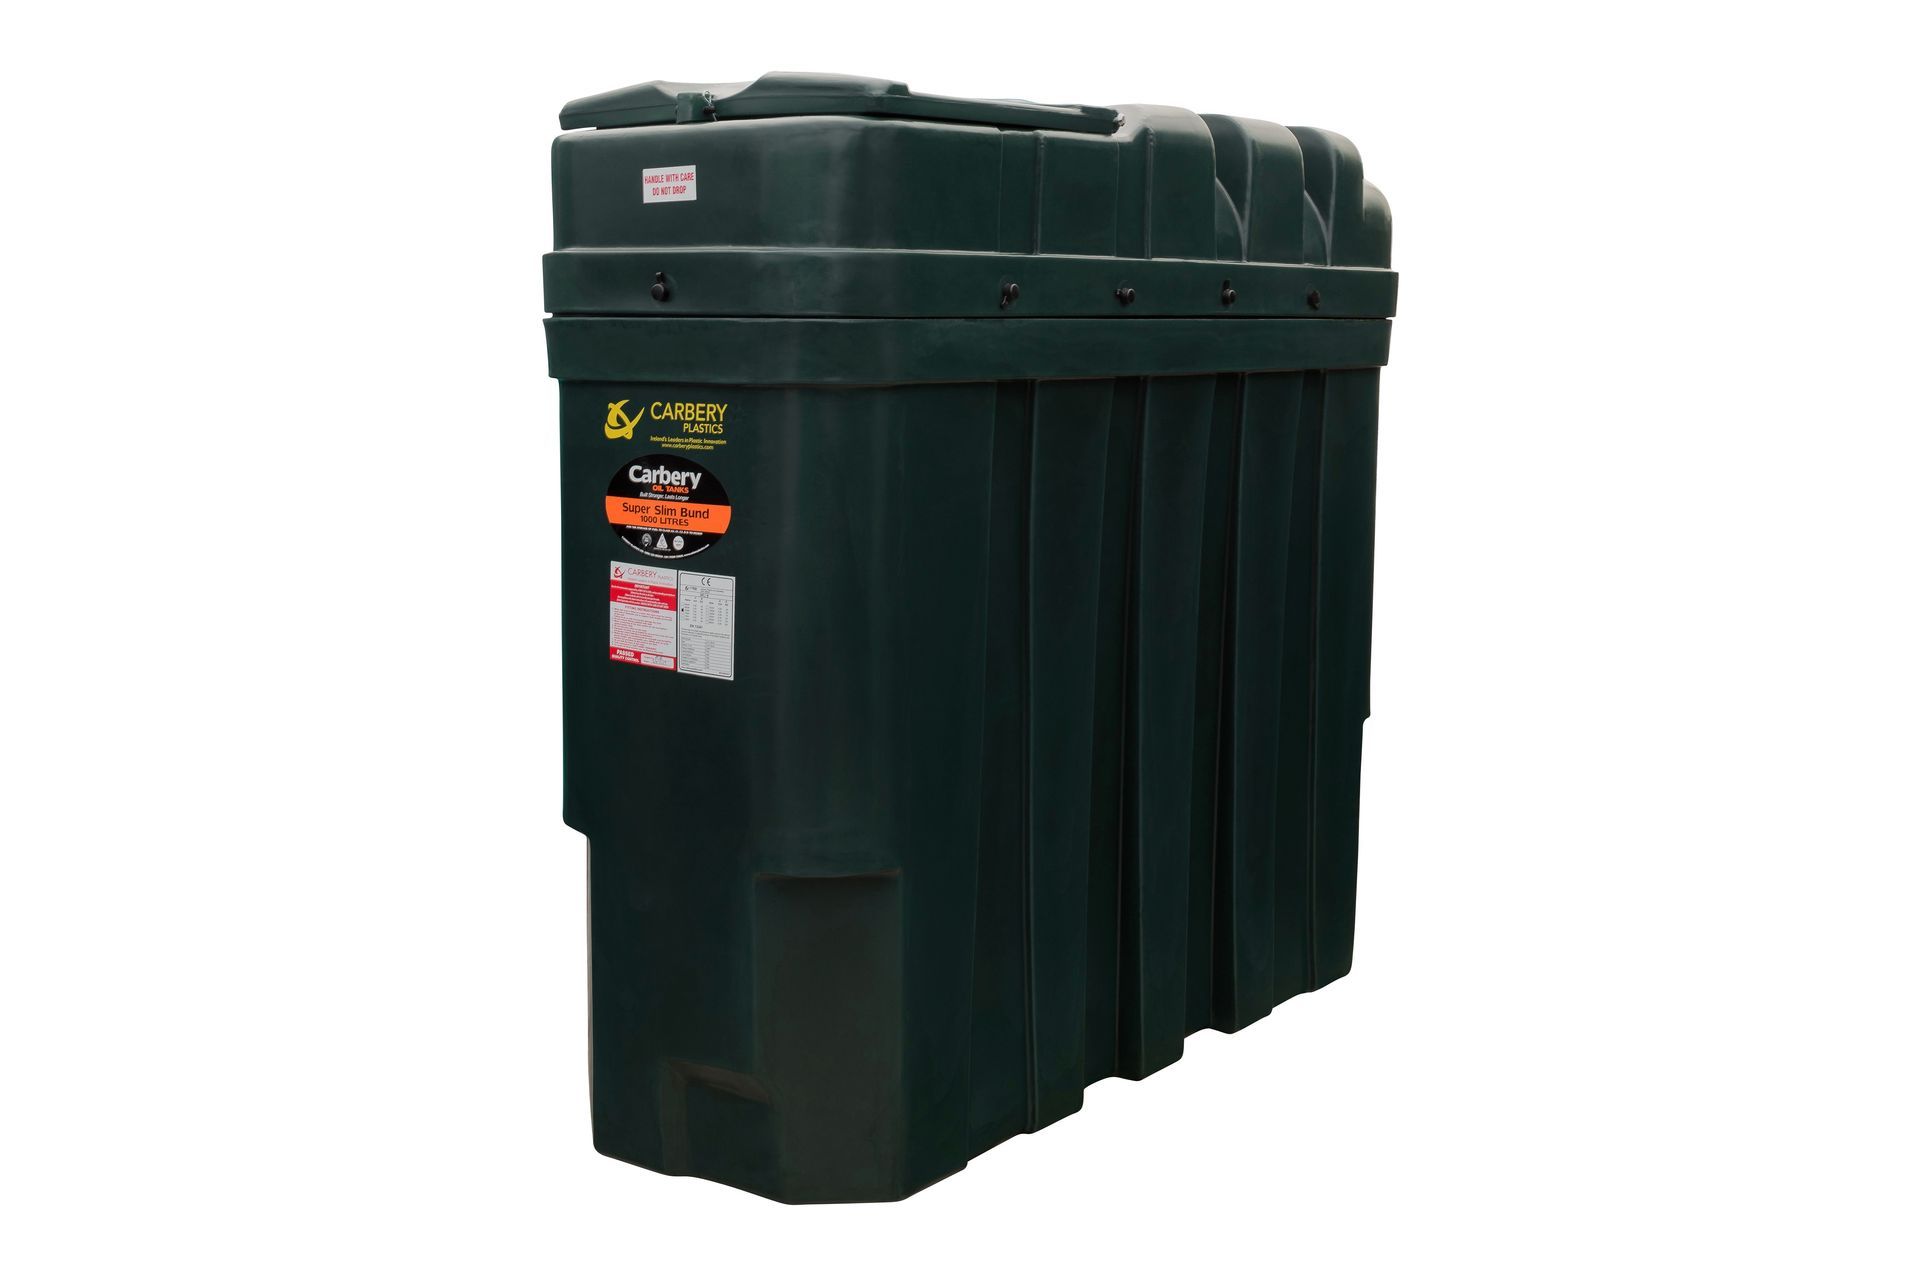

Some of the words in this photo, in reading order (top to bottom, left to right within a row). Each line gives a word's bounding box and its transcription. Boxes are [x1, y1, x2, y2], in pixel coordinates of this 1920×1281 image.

[645, 175, 664, 184] HANDLE
[666, 173, 679, 182] WITH
[680, 172, 694, 181] CARE
[652, 187, 659, 196] DO
[661, 187, 671, 195] NOT
[673, 185, 686, 195] DROP
[650, 401, 728, 421] CARBERY
[683, 423, 724, 434] PLASTICS
[628, 465, 702, 489] Carbery
[666, 485, 689, 493] TANKS
[622, 502, 651, 514] Super
[654, 504, 677, 516] Slim
[680, 507, 710, 519] Bund
[640, 515, 657, 524] 1000
[660, 517, 689, 526] LITRES
[628, 568, 657, 578] CARBERY
